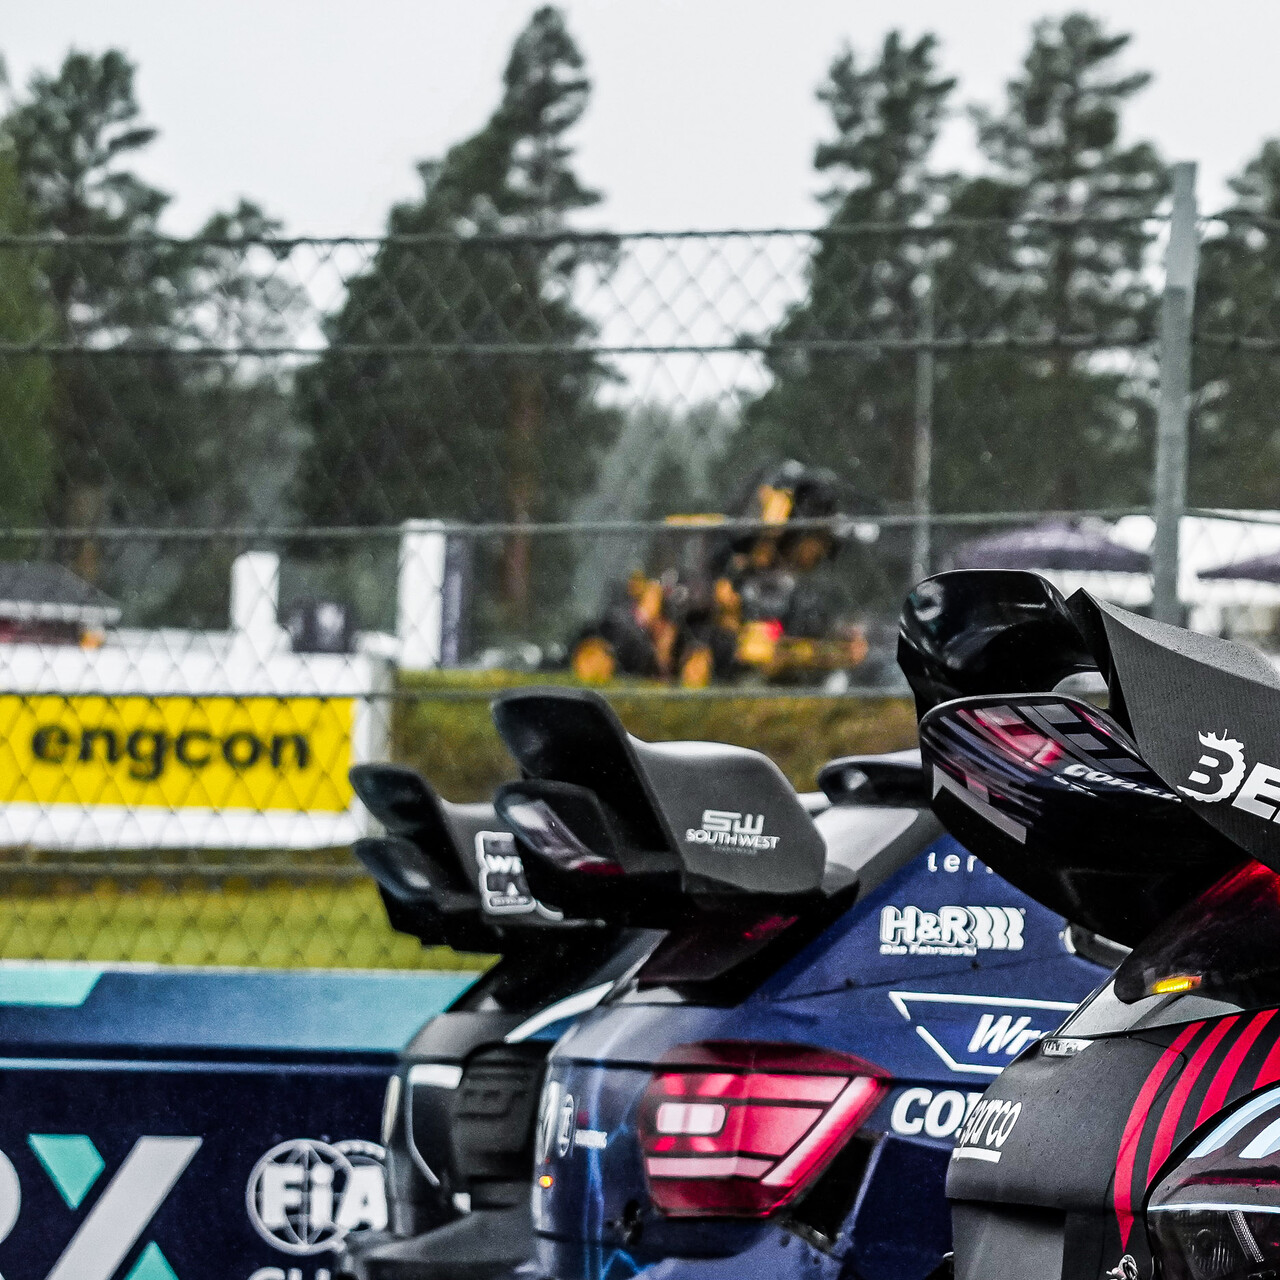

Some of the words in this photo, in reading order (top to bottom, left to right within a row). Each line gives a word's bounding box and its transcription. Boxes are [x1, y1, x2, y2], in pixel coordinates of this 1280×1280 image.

[32, 724, 311, 780] engcon
[702, 809, 764, 834] SW
[967, 1013, 1051, 1056] Wr
